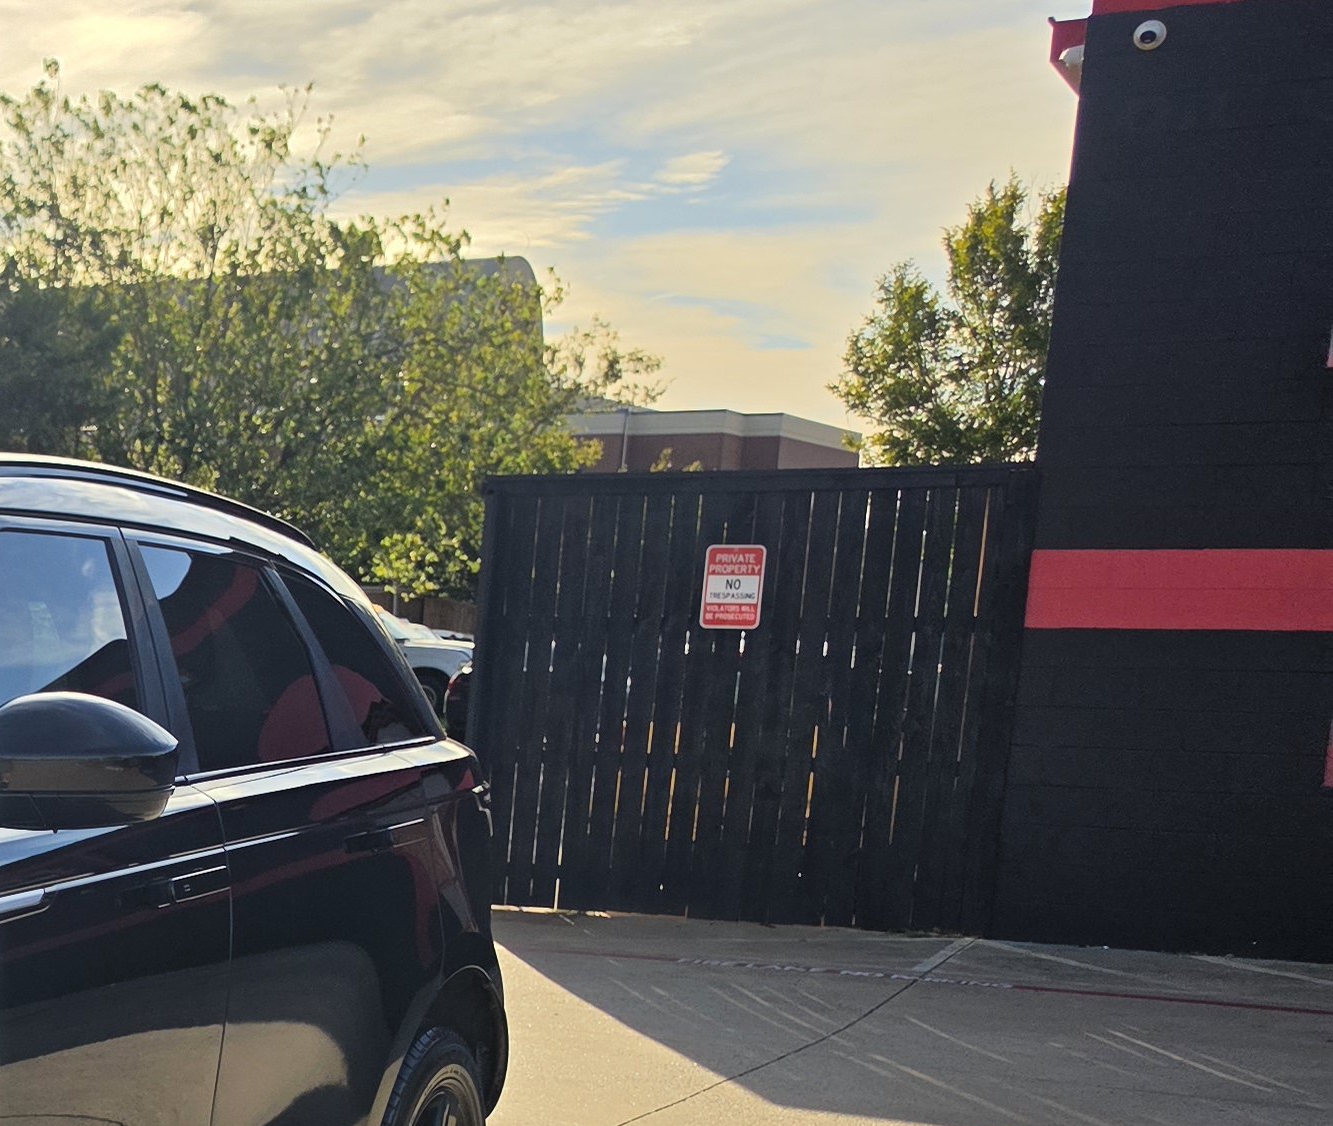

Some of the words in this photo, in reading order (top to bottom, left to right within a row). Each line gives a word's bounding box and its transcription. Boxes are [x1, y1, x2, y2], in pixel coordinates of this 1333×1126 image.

[716, 553, 756, 563] PRIVATE
[709, 564, 760, 574] PROPERTY
[725, 579, 741, 590] NO
[709, 592, 756, 600] TRESPASSING
